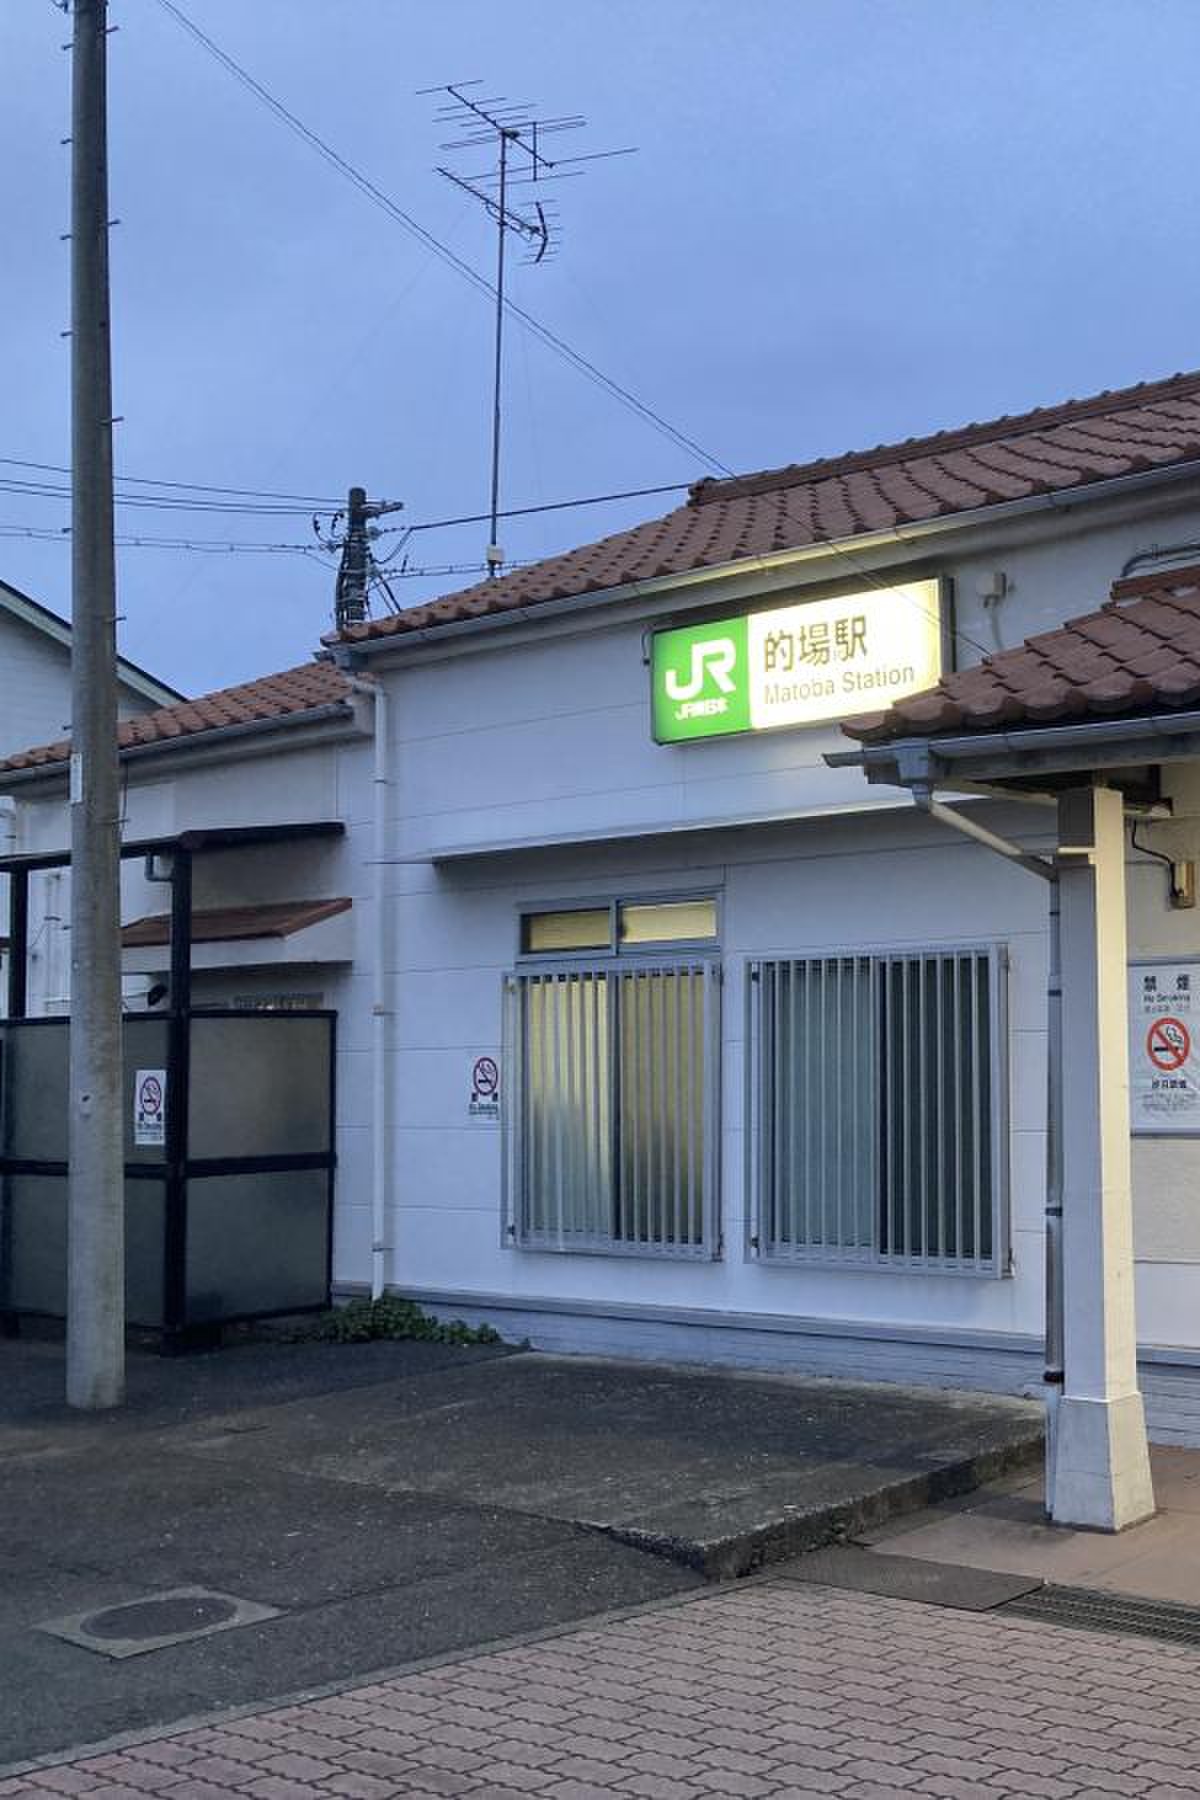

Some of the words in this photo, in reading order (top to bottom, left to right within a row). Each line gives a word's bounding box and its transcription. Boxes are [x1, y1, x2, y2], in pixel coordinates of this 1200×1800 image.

[665, 638, 736, 700] JR
[764, 615, 867, 673] 的場駅
[764, 677, 835, 705] Matoba
[842, 665, 914, 693] Station
